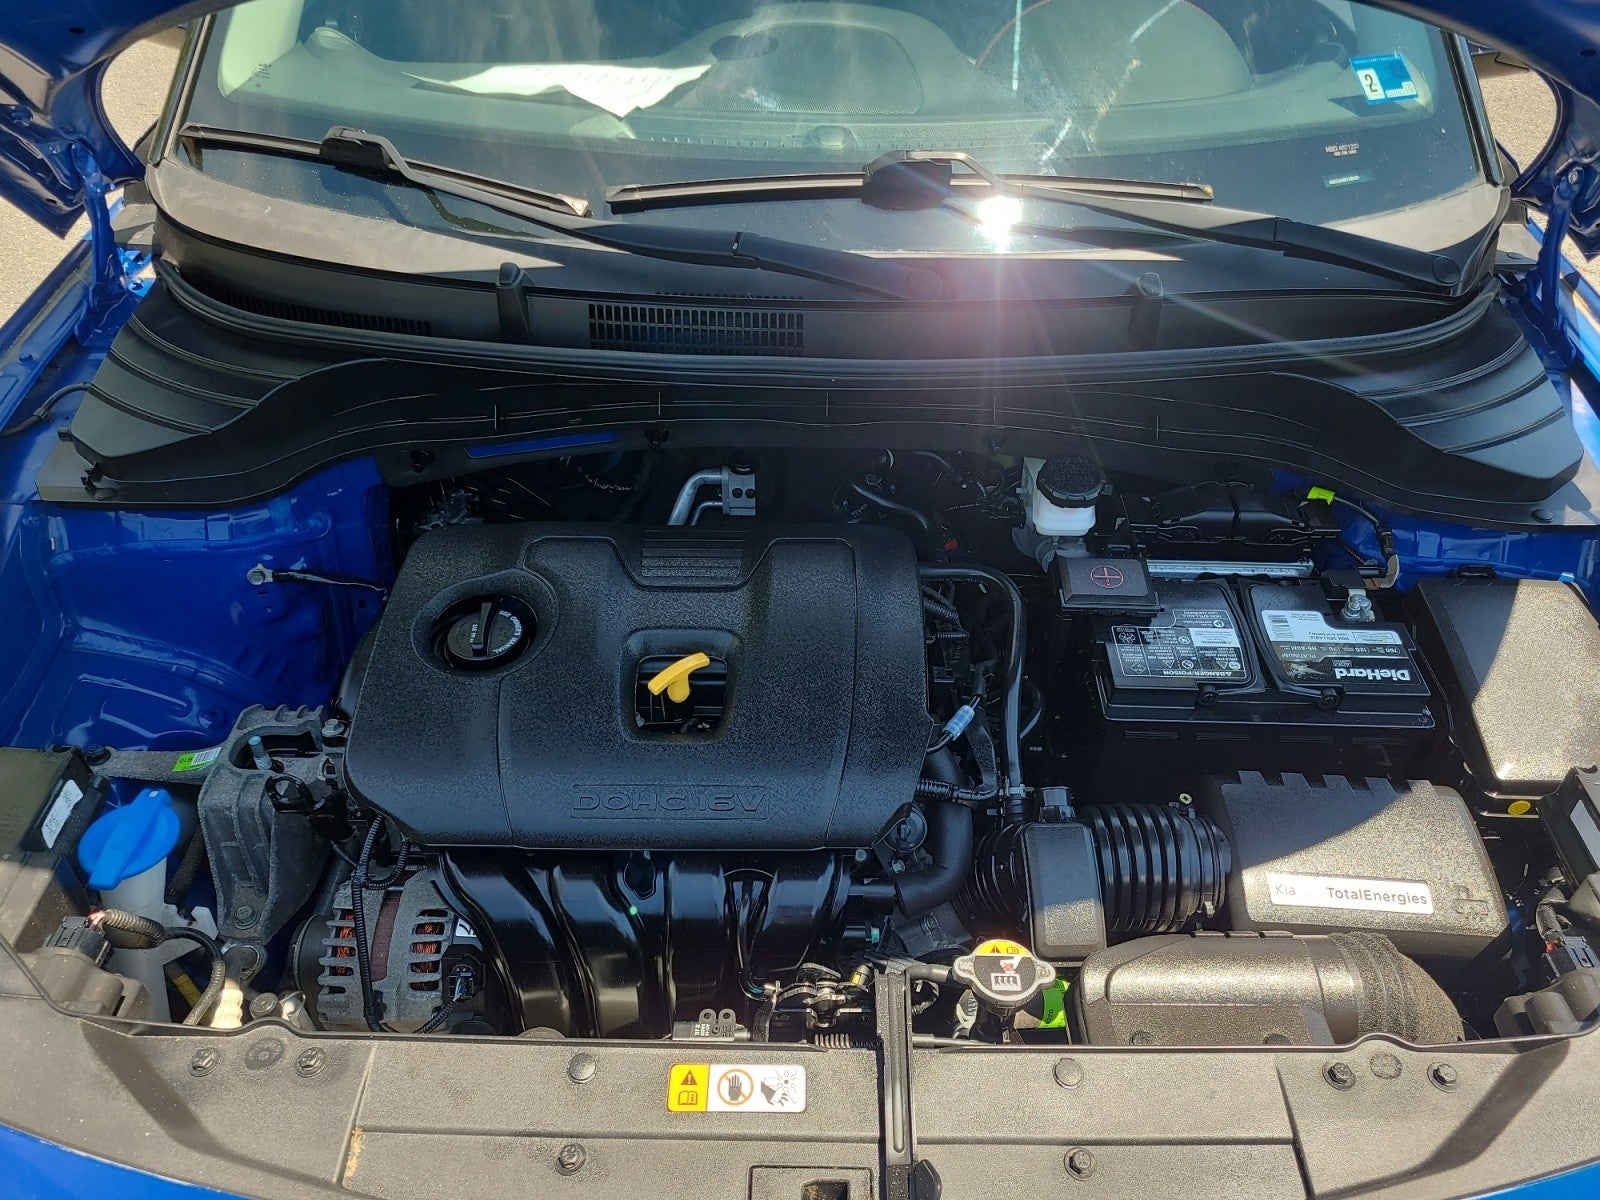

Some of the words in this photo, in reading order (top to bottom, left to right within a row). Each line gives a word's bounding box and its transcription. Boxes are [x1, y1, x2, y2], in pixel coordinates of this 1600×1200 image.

[1364, 73, 1378, 93] 2
[1335, 668, 1411, 681] DieHard
[573, 792, 688, 812] DOHC
[698, 792, 766, 812] 16V
[1274, 883, 1296, 897] Kia
[1326, 886, 1427, 905] TotalEnergies
